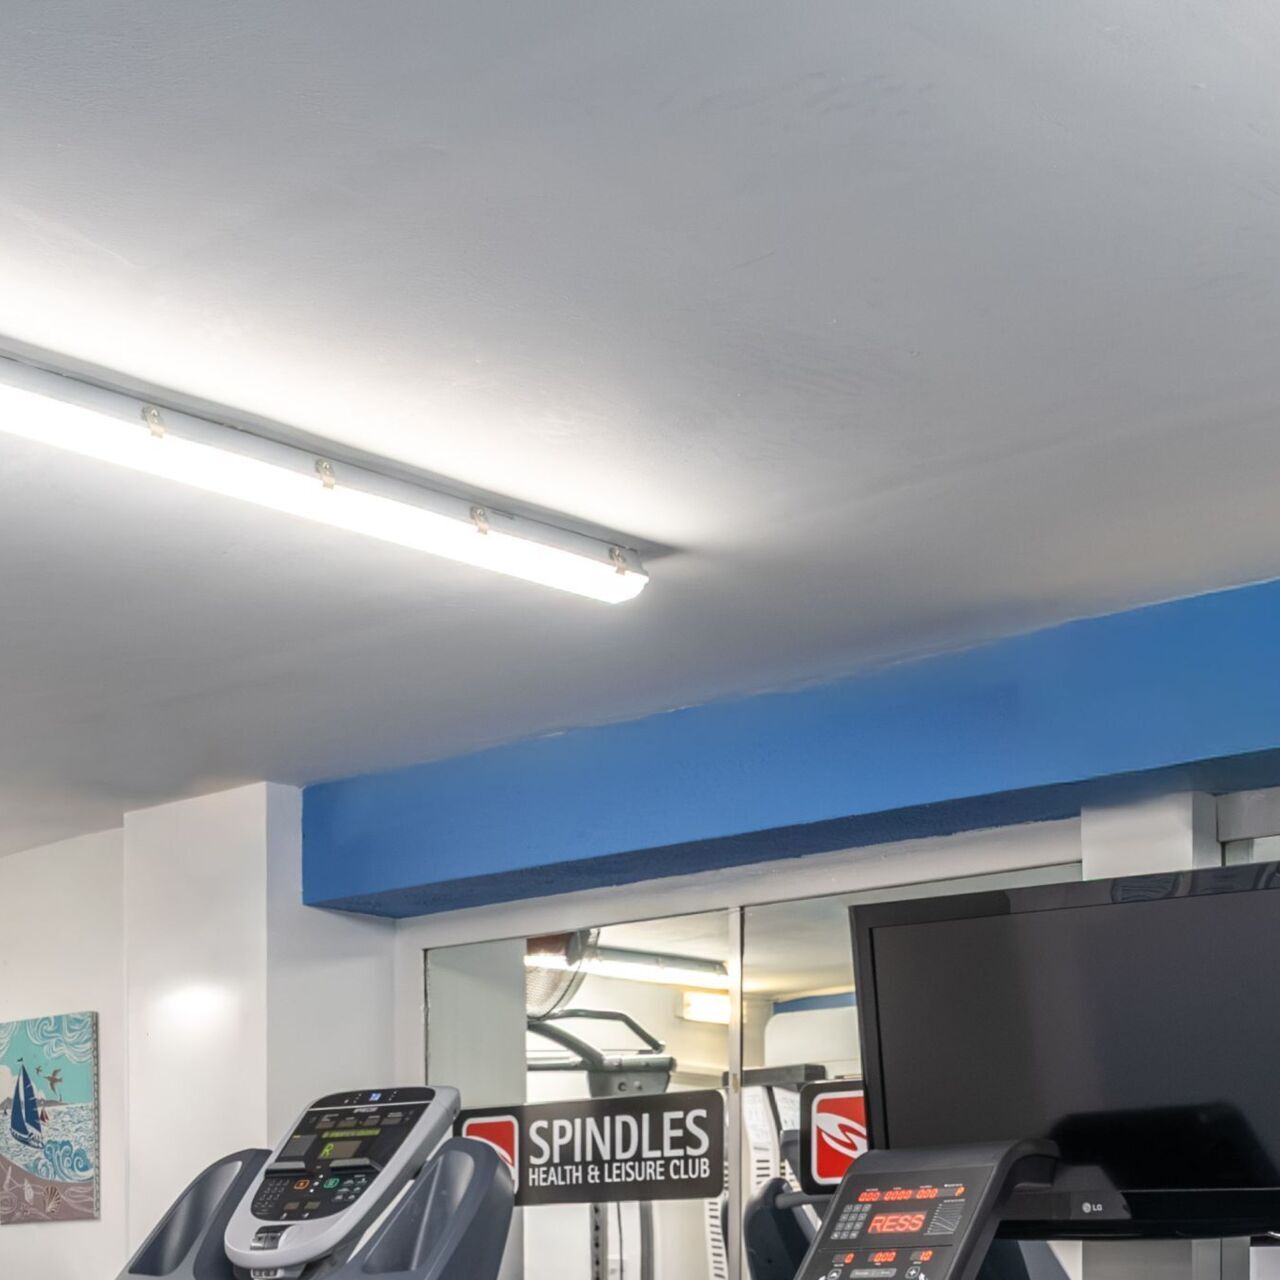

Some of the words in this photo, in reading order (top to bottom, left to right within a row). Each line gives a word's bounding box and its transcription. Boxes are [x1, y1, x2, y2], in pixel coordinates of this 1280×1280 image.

[529, 1108, 710, 1165] SPINDLES
[528, 1165, 582, 1187] HEALTH
[587, 1165, 600, 1183] &
[604, 1160, 665, 1183] LEISURE
[670, 1157, 710, 1180] CLUB
[1092, 1203, 1103, 1211] LG
[868, 1214, 925, 1233] RESS
